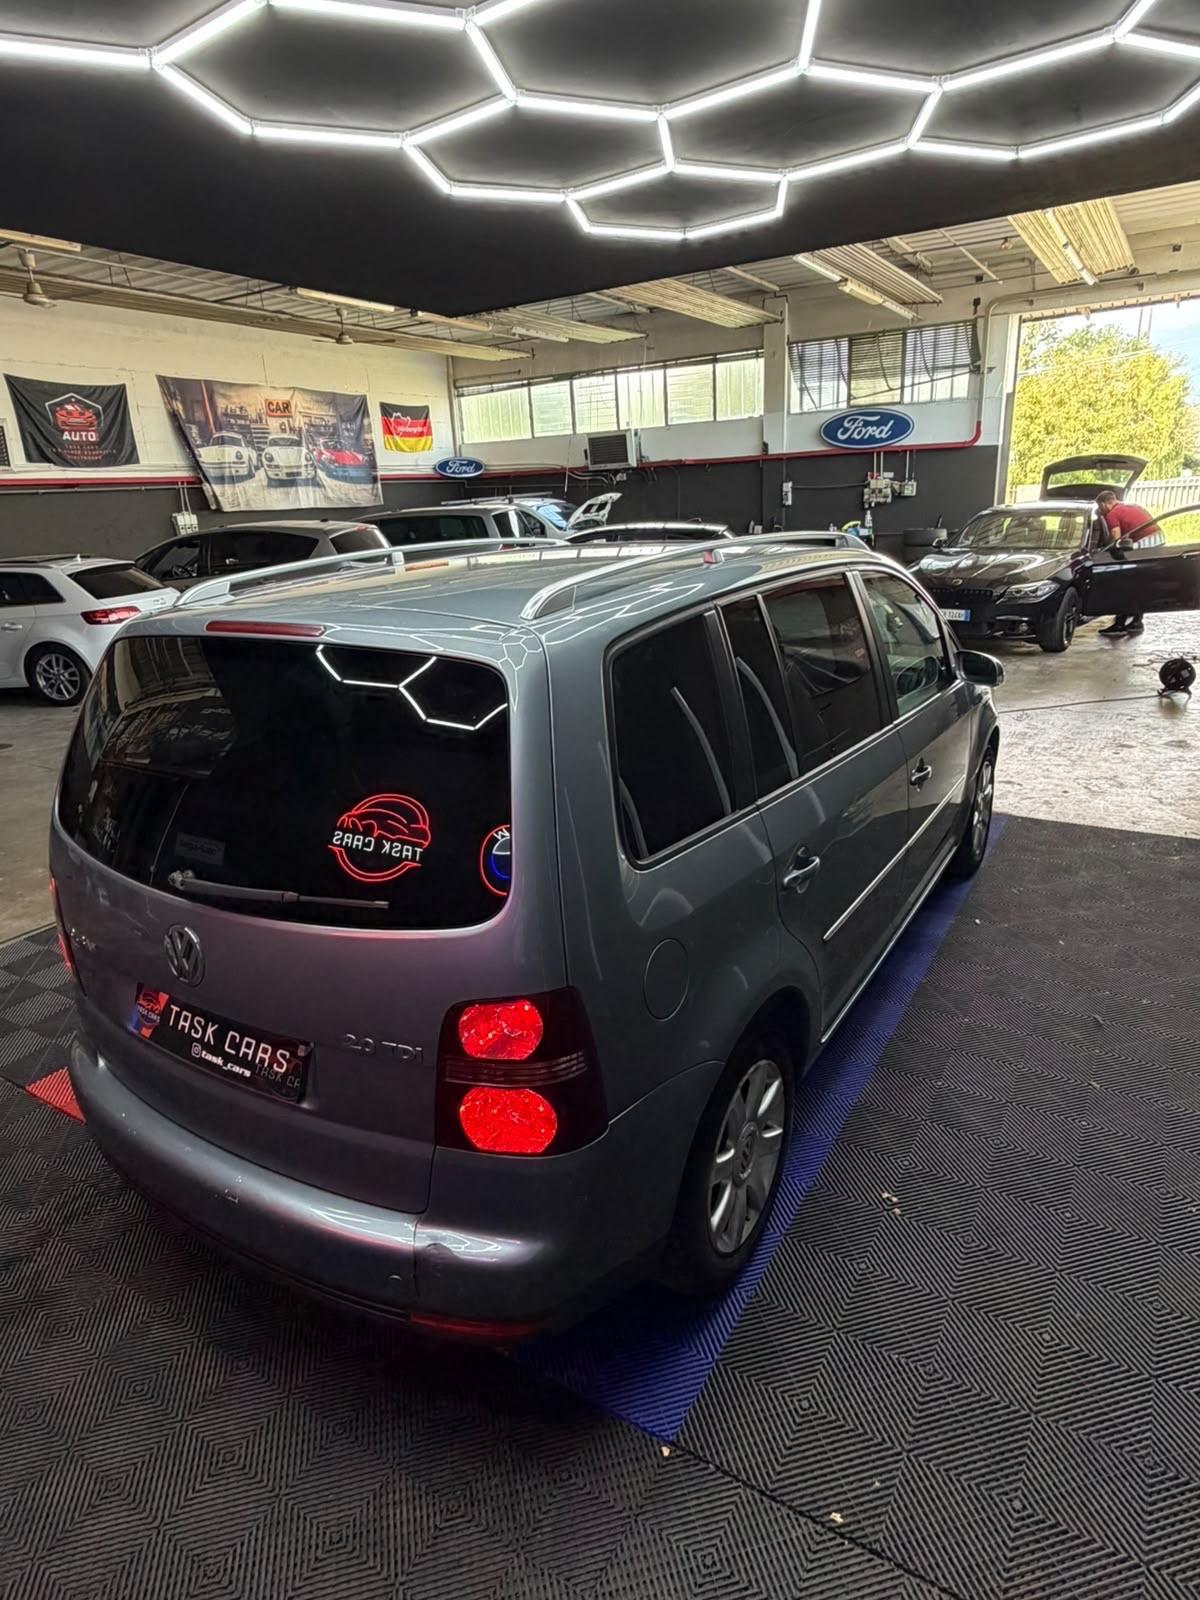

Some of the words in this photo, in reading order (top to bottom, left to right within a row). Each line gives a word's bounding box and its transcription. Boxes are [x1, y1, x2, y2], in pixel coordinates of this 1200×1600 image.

[267, 401, 290, 414] CAR
[63, 431, 97, 441] AUTO
[837, 415, 894, 440] Ford
[446, 460, 475, 474] Ford
[169, 1004, 219, 1046] TASK
[224, 1031, 290, 1073] CARS
[201, 1050, 251, 1078] task_cars
[255, 1063, 282, 1083] TASK
